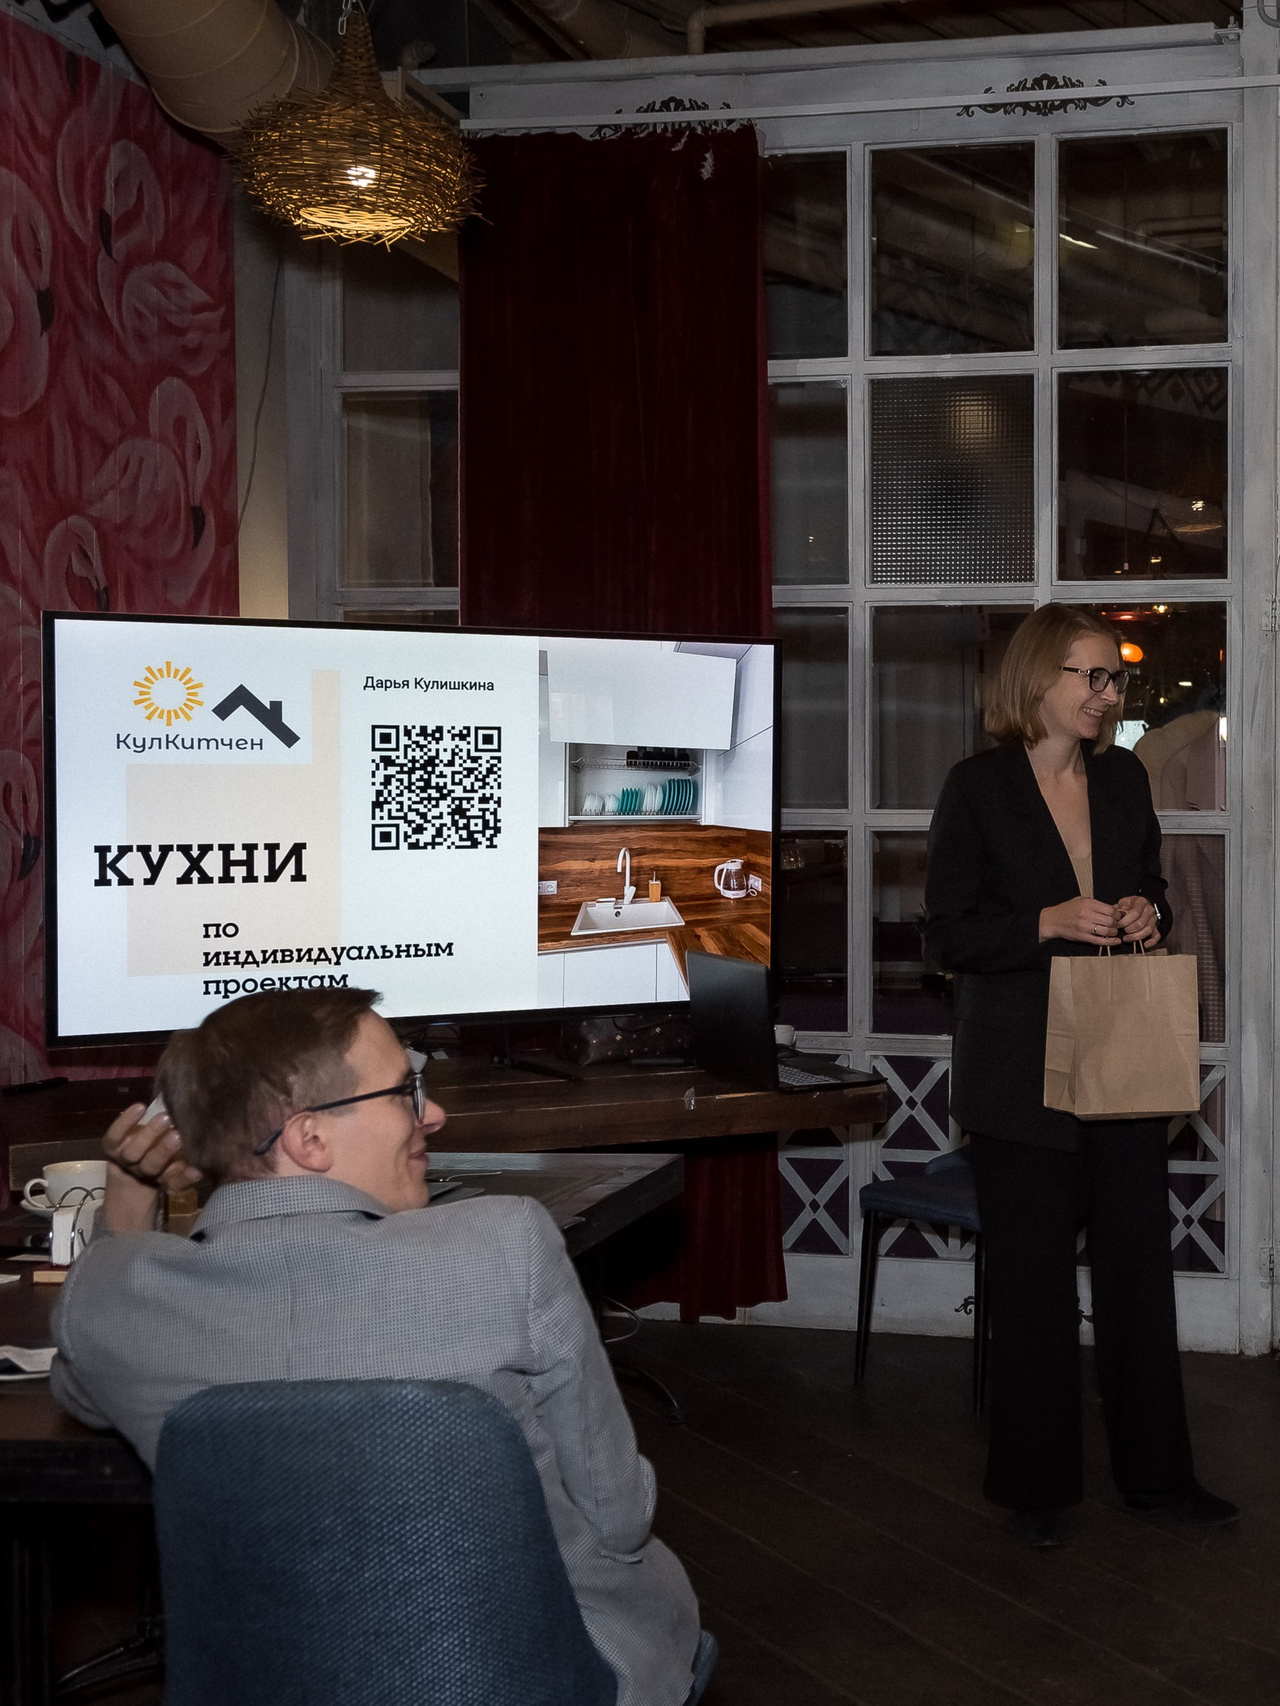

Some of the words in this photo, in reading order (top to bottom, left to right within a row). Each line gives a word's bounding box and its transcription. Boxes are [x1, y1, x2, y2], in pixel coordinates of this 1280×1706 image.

[363, 676, 409, 691] Дарья
[414, 677, 495, 692] Кулишкина
[116, 733, 263, 753] КулКитчен
[94, 842, 307, 887] КУХНИ
[202, 922, 239, 938] по
[202, 942, 454, 968] индивидуальным
[202, 974, 349, 999] проектам
